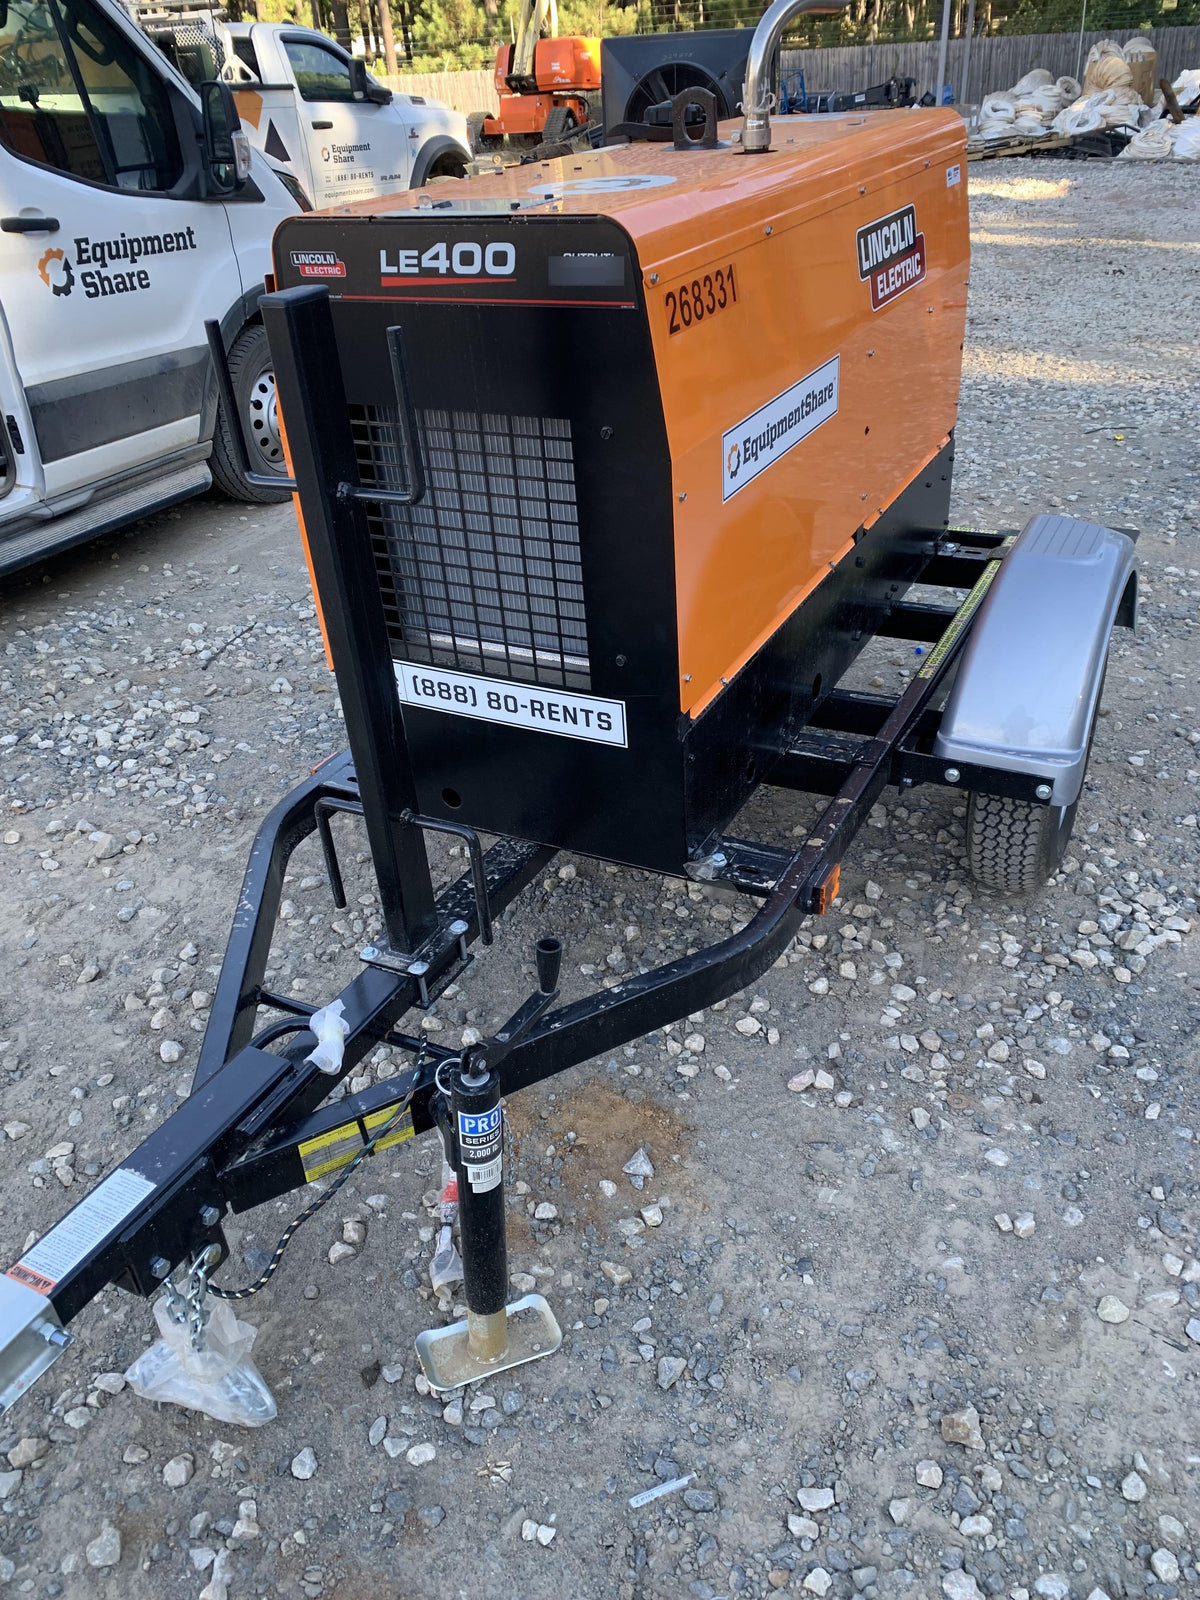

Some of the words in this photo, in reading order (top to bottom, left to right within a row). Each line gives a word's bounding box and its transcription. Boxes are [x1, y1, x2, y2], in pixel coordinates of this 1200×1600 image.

[331, 142, 371, 154] Equipment
[333, 155, 355, 163] Share
[73, 226, 197, 268] Equipment
[860, 213, 914, 272] LINCOLN
[292, 254, 335, 265] LINCOLN
[305, 266, 341, 275] ELECTRIC
[380, 242, 516, 275] LE400
[80, 269, 151, 299] Share
[876, 252, 922, 300] ELECTRIC
[665, 264, 737, 336] 268331
[742, 382, 834, 465] EquipmentShare
[412, 675, 477, 707] (888)
[486, 691, 613, 732] 80-RENTS
[464, 1110, 499, 1133] PRO
[465, 1129, 500, 1145] SERIES
[469, 1147, 491, 1159] 2,000
